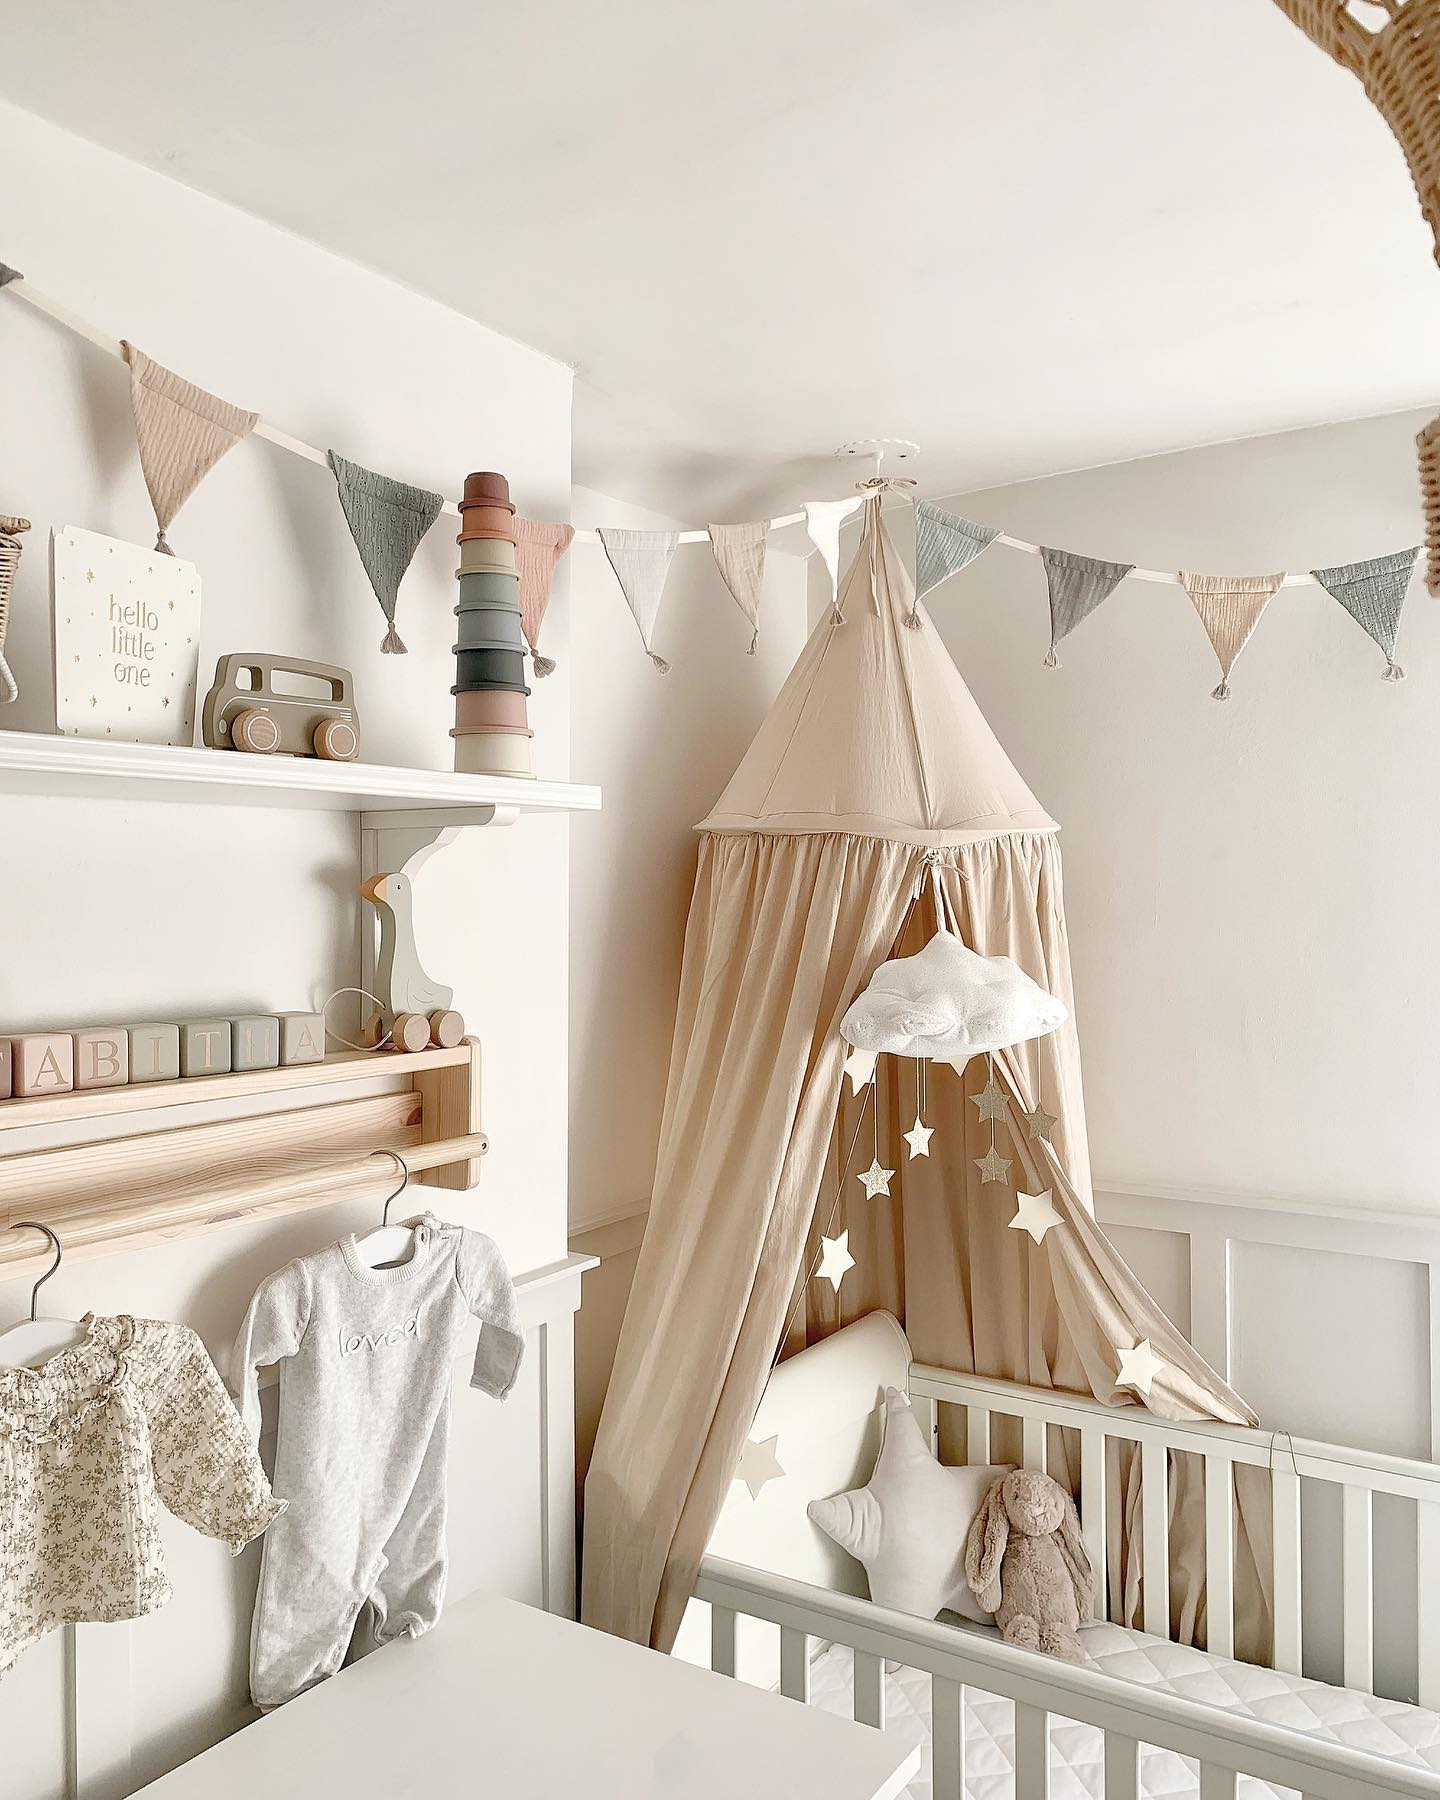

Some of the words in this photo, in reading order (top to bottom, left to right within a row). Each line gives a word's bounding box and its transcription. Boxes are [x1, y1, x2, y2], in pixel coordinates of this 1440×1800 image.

[108, 593, 159, 631] hello
[112, 625, 155, 661] little
[114, 662, 151, 688] one
[0, 1022, 321, 1089] ABITHA
[338, 1304, 421, 1358] loved
